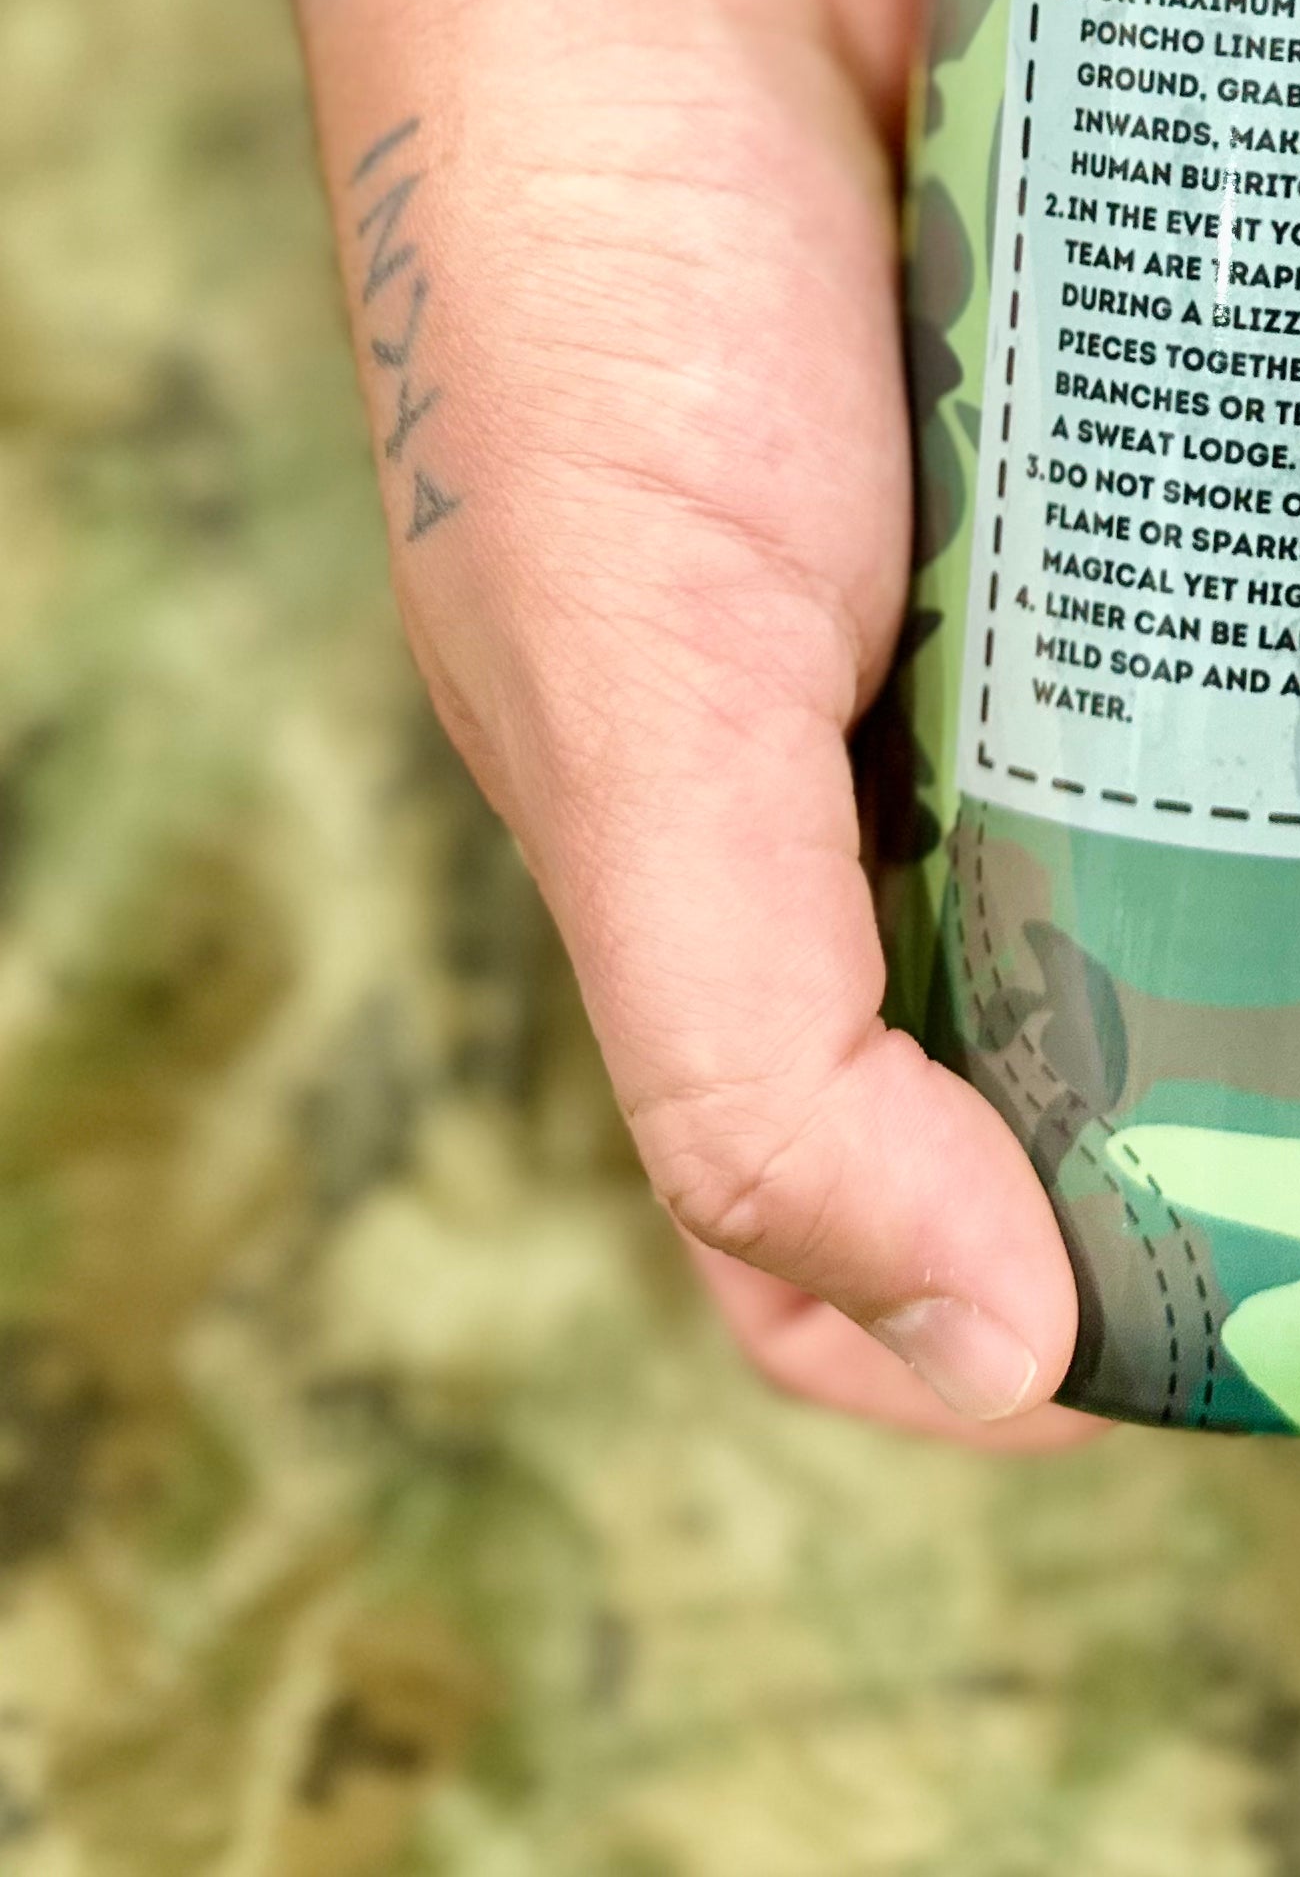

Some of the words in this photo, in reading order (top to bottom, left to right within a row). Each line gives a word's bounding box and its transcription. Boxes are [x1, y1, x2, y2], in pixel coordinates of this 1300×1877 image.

[1080, 19, 1204, 55] PONCHO
[1077, 62, 1207, 101] GROUND,
[1074, 107, 1218, 150] INWARDS,
[1071, 151, 1172, 187] HUMAN
[1105, 202, 1158, 230] THE
[1064, 239, 1135, 272] TEAM
[1144, 251, 1200, 280] ARE
[1062, 283, 1172, 321] DURING
[1181, 300, 1201, 326] A
[1058, 327, 1157, 365] PIECES
[1055, 372, 1210, 416] BRANCHES
[1220, 395, 1264, 424] OR
[1051, 415, 1069, 440] A
[1078, 421, 1174, 458] SWEAT
[1184, 435, 1296, 470] LODGE.
[1096, 470, 1154, 502] NOT
[1164, 481, 1271, 515] SMOKE
[1045, 503, 1130, 541] FLAME
[1140, 521, 1182, 547] OR
[1042, 549, 1174, 594] MAGICAL
[1182, 574, 1238, 602] YET
[1015, 587, 1035, 612] 4.
[1045, 594, 1125, 630] LINER
[1134, 609, 1201, 643] CAN
[1211, 621, 1248, 647] BE
[1036, 634, 1101, 672] MILD
[1110, 650, 1193, 684] SOAP
[1201, 665, 1270, 694] AND
[1032, 678, 1132, 723] WATER.
